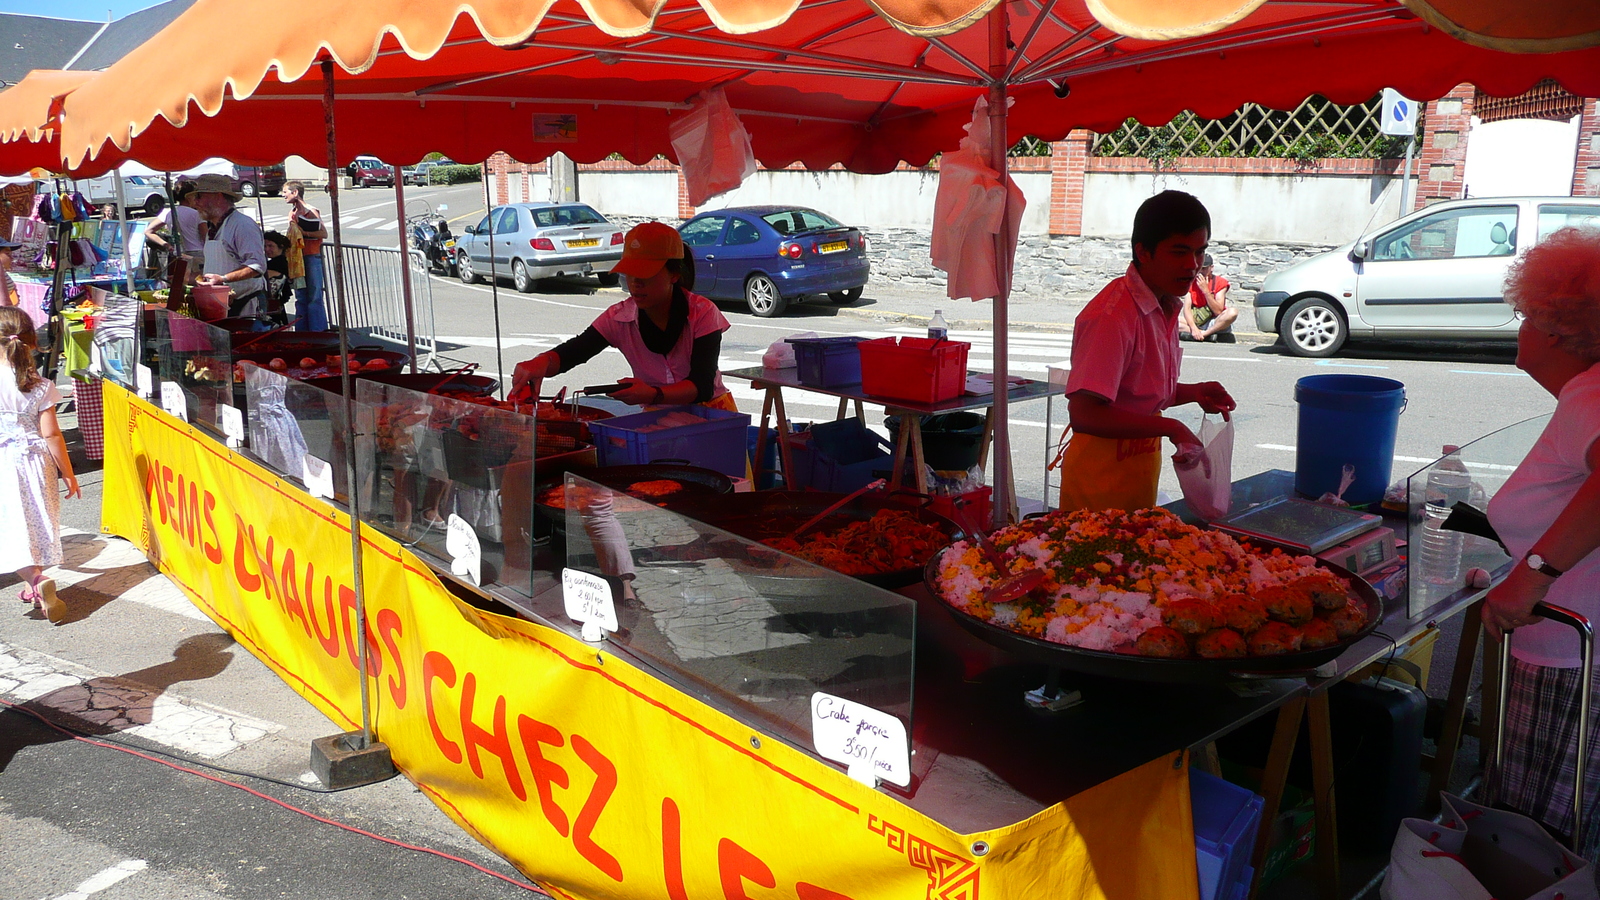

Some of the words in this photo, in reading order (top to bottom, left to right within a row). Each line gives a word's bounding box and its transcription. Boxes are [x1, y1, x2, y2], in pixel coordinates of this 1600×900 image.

[147, 459, 222, 565] NEMS
[234, 512, 406, 710] CHAUDS
[422, 650, 623, 882] CHEZ
[816, 697, 850, 723] Crabe
